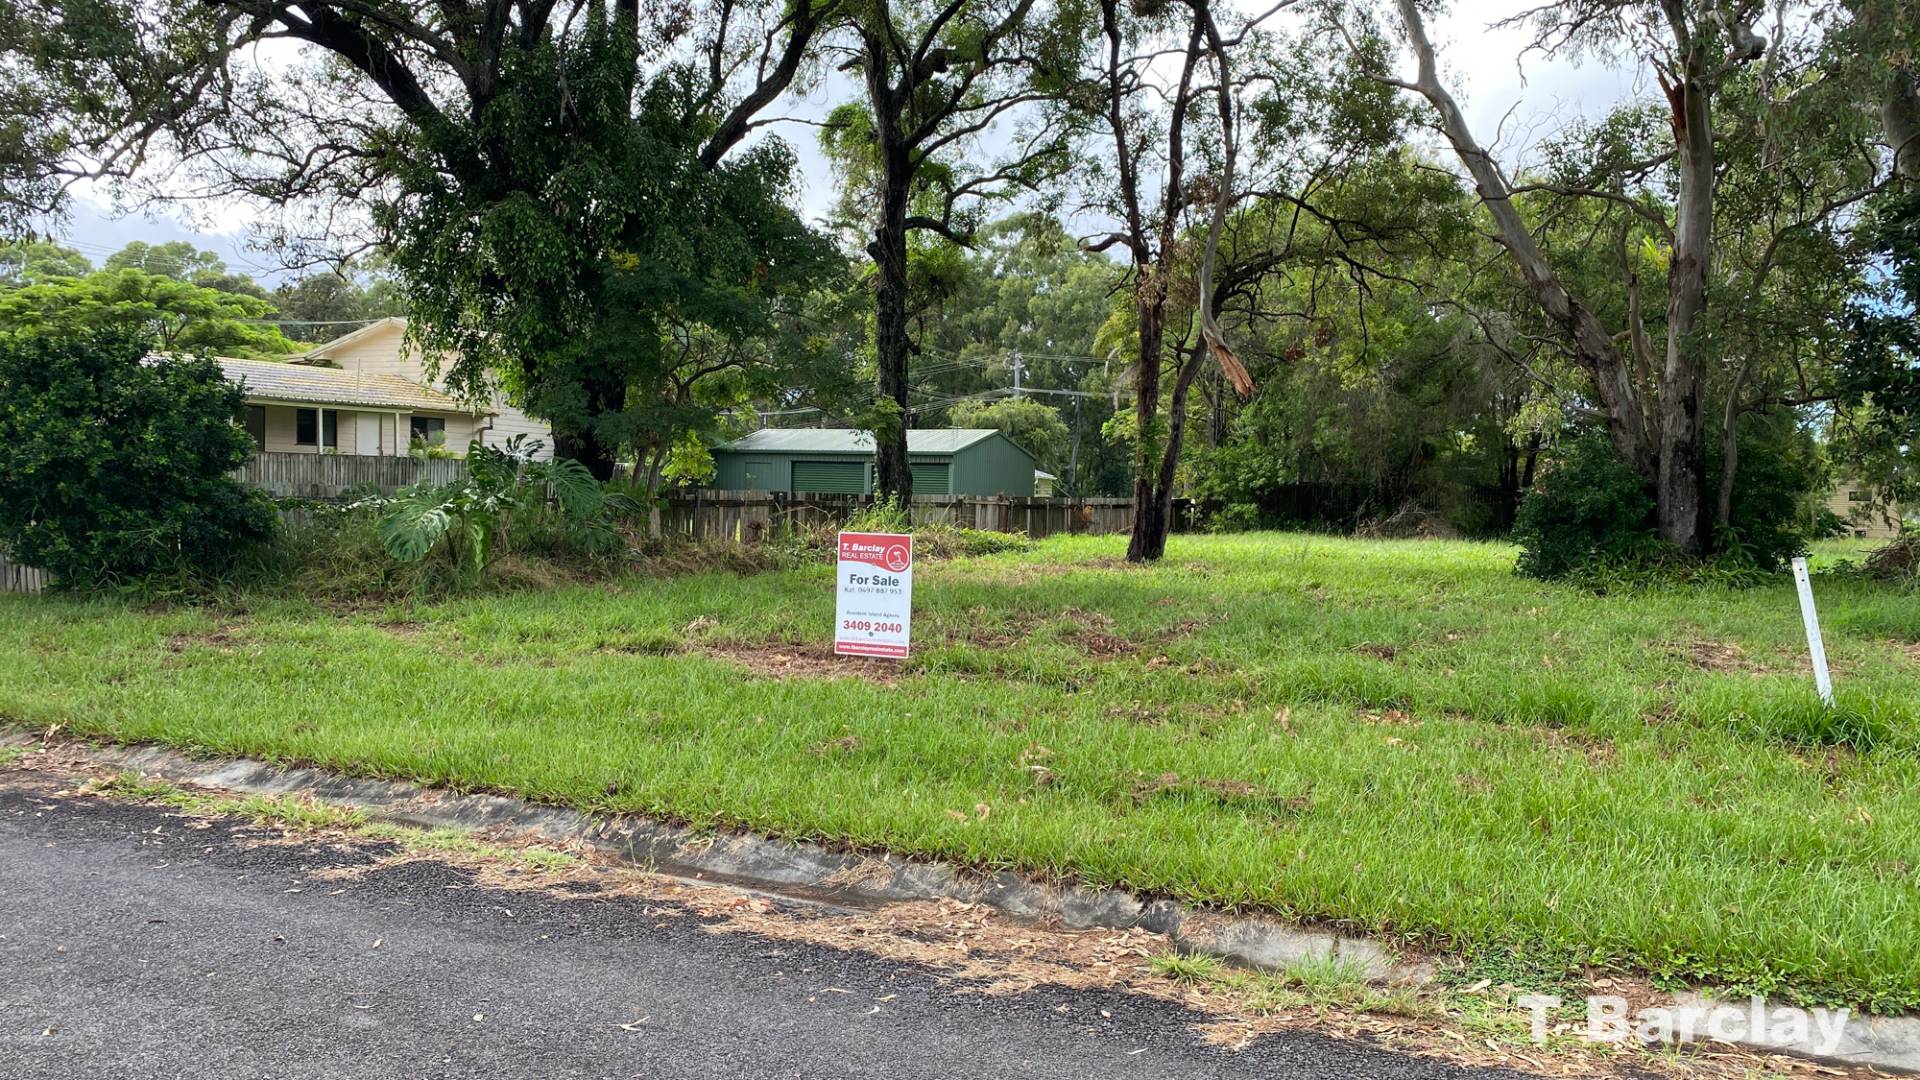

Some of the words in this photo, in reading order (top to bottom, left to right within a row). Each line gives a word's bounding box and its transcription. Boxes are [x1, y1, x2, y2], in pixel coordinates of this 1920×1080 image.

[852, 543, 885, 553] Barclay
[850, 574, 869, 585] For
[873, 575, 899, 586] Sale
[843, 620, 871, 631] 3409
[874, 622, 902, 633] 2040
